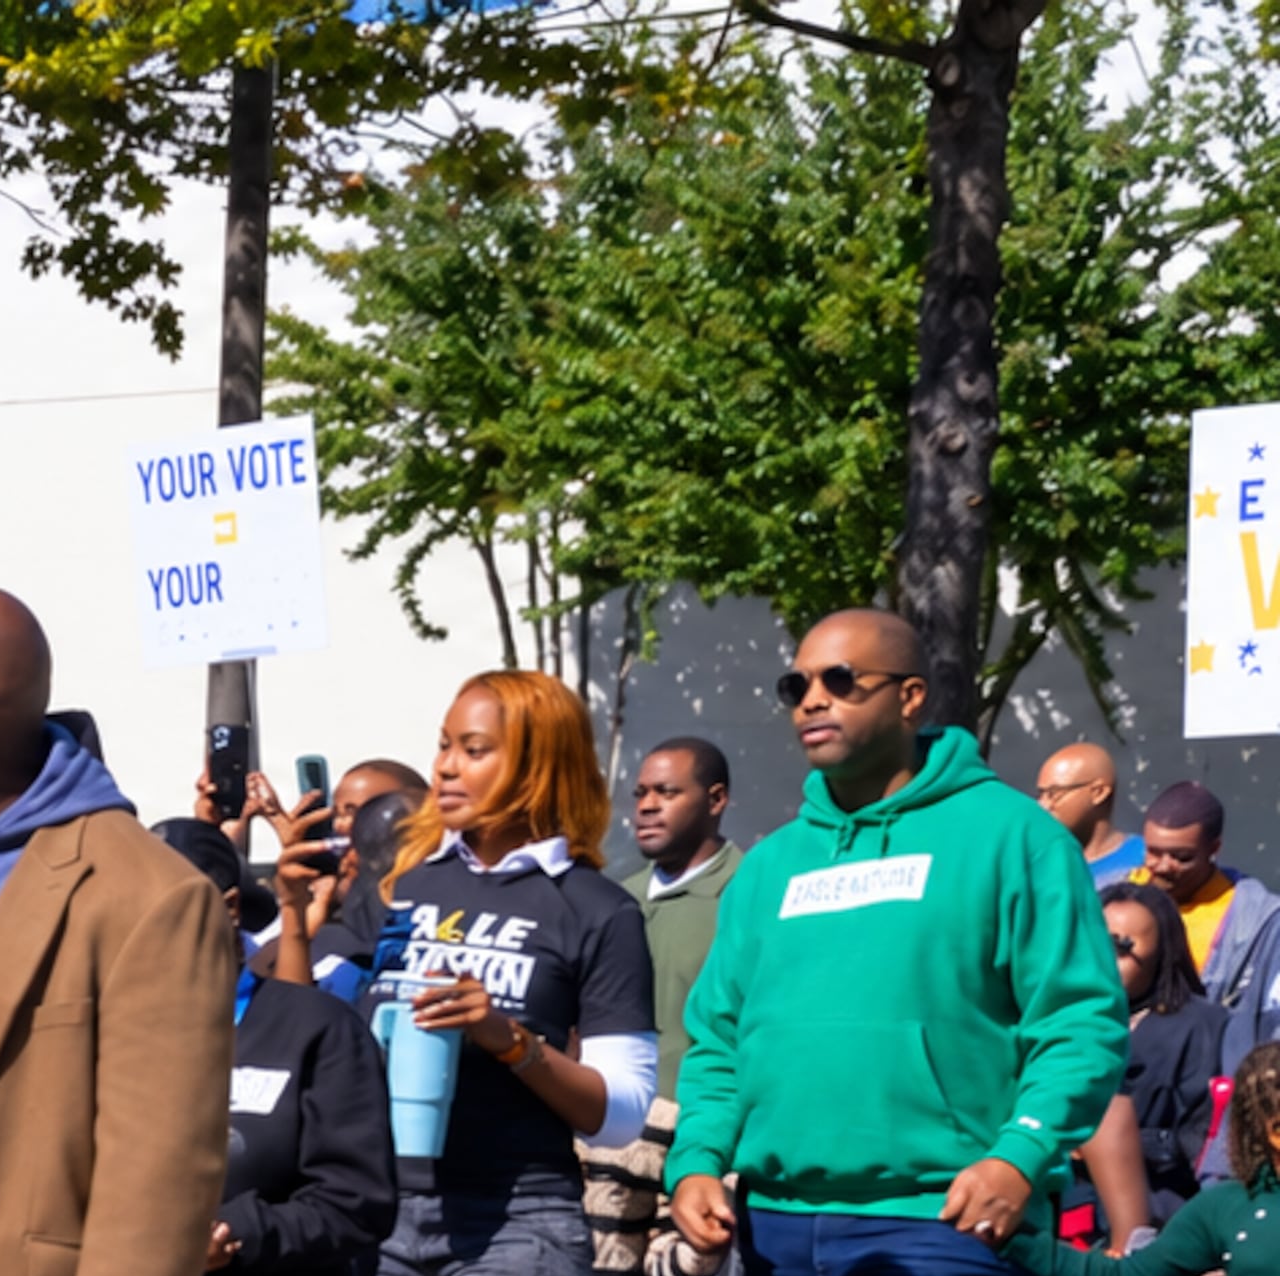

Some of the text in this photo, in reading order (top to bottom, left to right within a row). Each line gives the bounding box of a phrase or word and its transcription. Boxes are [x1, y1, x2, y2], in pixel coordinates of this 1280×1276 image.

[137, 439, 307, 504] YOUR VOTE
[147, 561, 223, 612] YOUR
